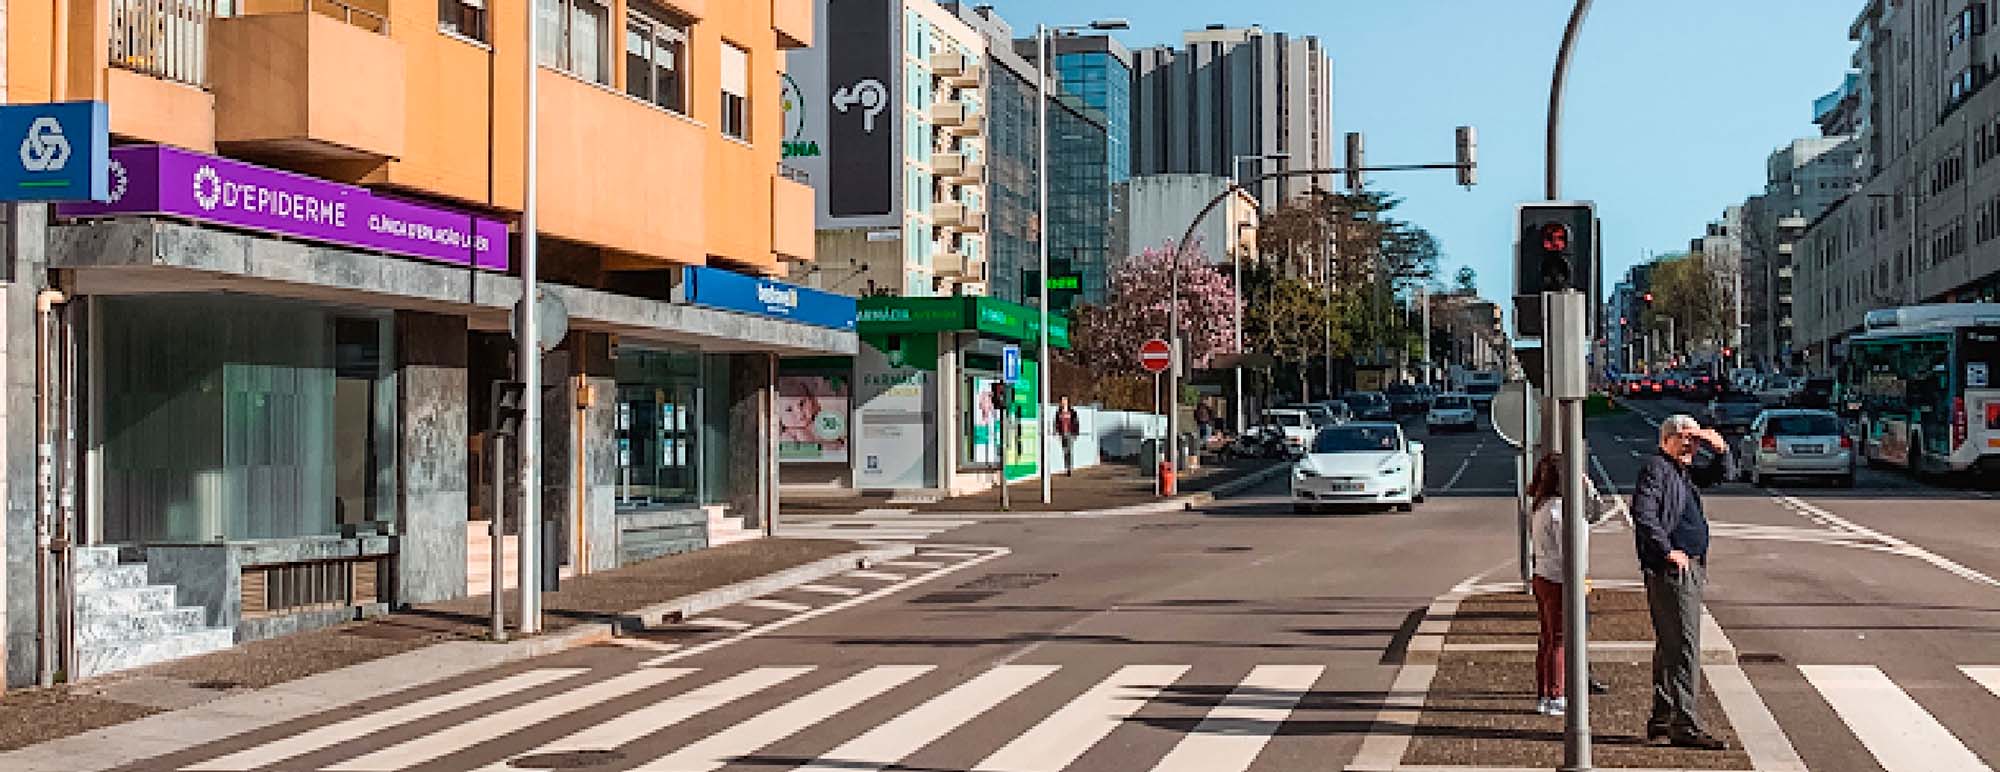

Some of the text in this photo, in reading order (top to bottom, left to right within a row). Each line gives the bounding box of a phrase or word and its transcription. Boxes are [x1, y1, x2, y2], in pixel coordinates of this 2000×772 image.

[223, 181, 346, 227] D'EPIDERME
[461, 232, 488, 250] LAER
[857, 306, 910, 321] ARMÁCIA
